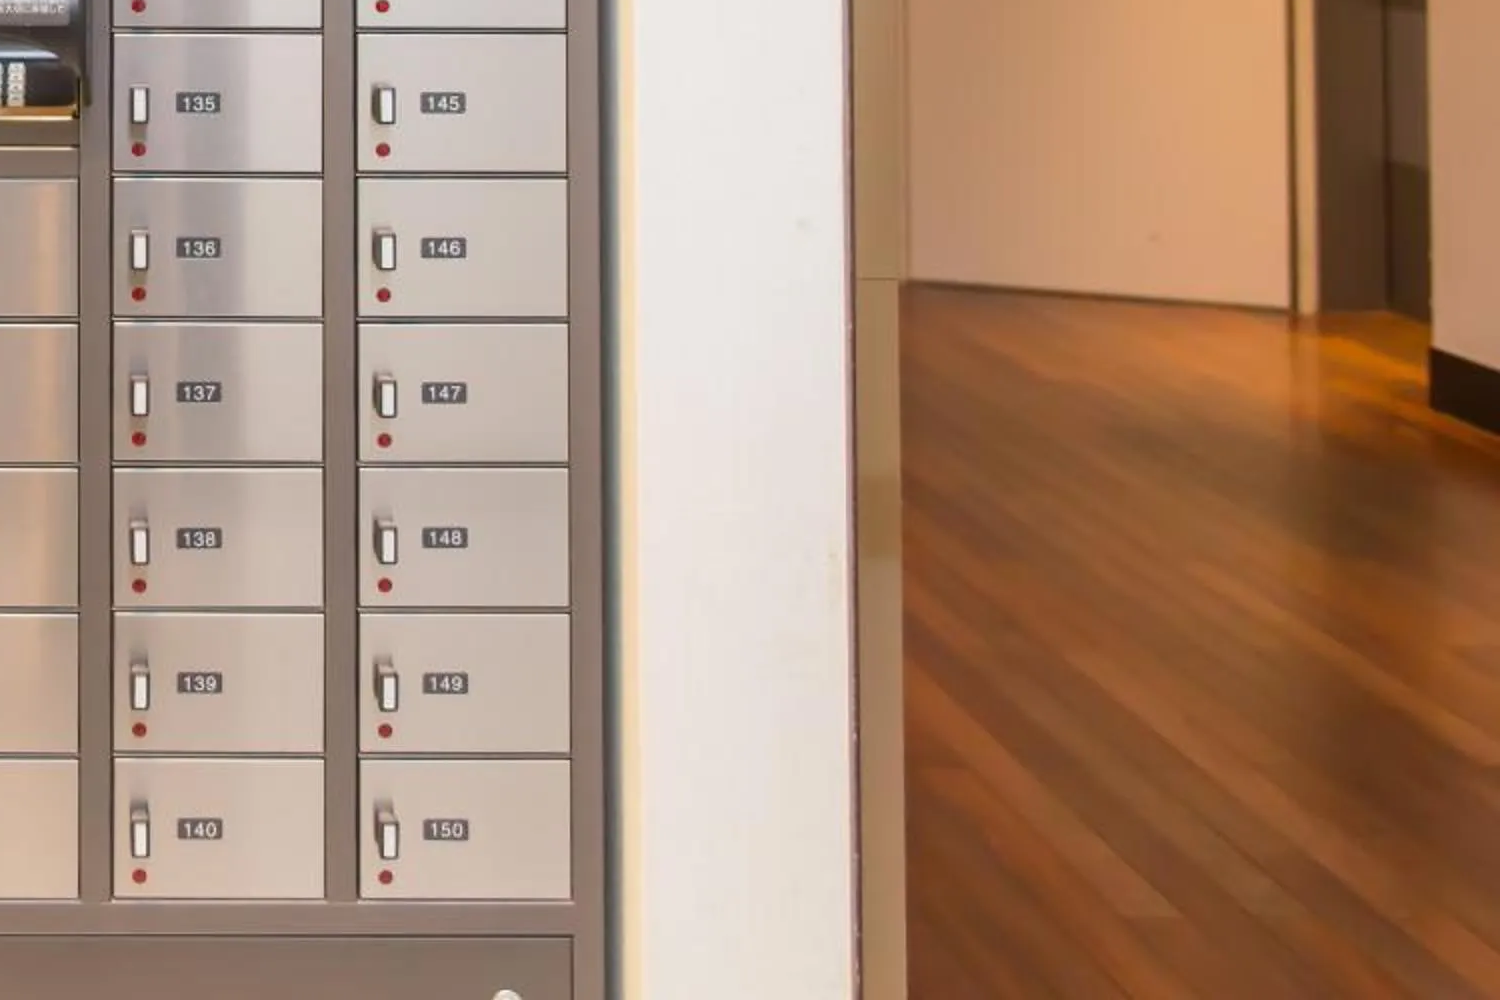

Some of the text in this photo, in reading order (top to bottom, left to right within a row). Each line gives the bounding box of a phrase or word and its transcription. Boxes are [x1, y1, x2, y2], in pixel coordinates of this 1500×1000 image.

[183, 95, 216, 112] 135
[428, 95, 460, 111] 145
[183, 240, 216, 257] 136
[428, 240, 461, 256] 146
[183, 385, 216, 401] 137
[429, 385, 462, 401] 147
[183, 531, 216, 548] 138
[429, 529, 462, 546] 148
[183, 675, 217, 691] 139
[430, 675, 463, 692] 149
[184, 821, 217, 837] 140
[431, 821, 464, 838] 150
